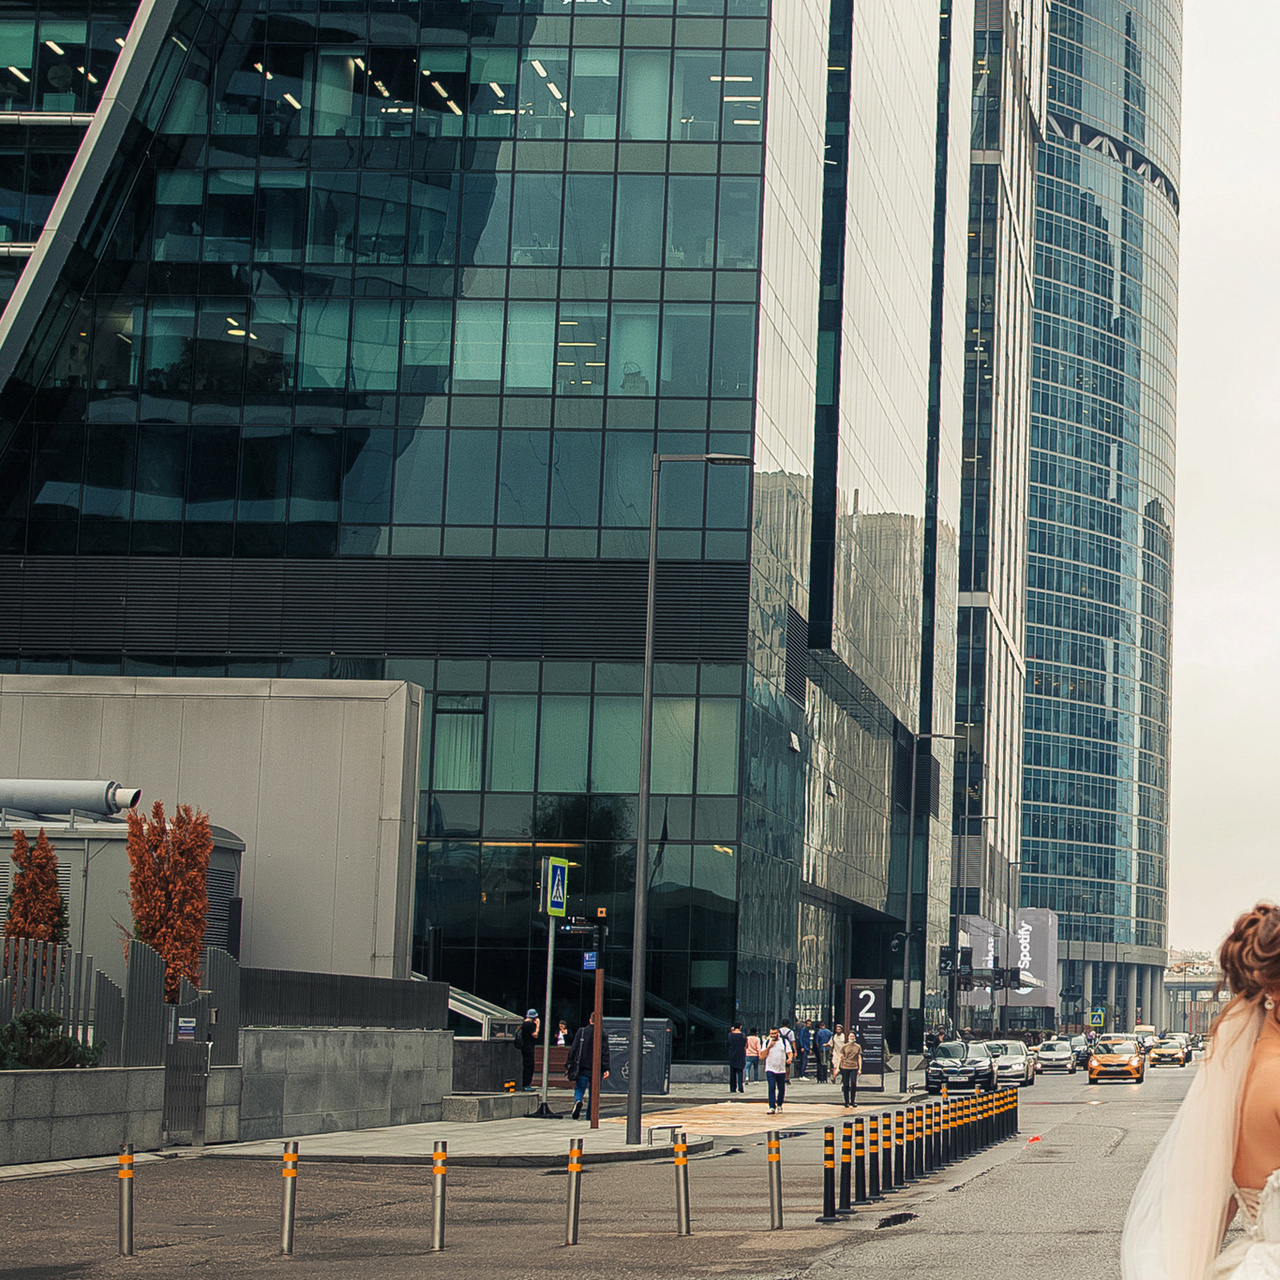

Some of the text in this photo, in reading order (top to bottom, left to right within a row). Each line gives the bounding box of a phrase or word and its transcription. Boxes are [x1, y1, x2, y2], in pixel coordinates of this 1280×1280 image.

[1017, 922, 1032, 969] Spotify
[946, 960, 952, 970] 2
[859, 990, 876, 1018] 2
